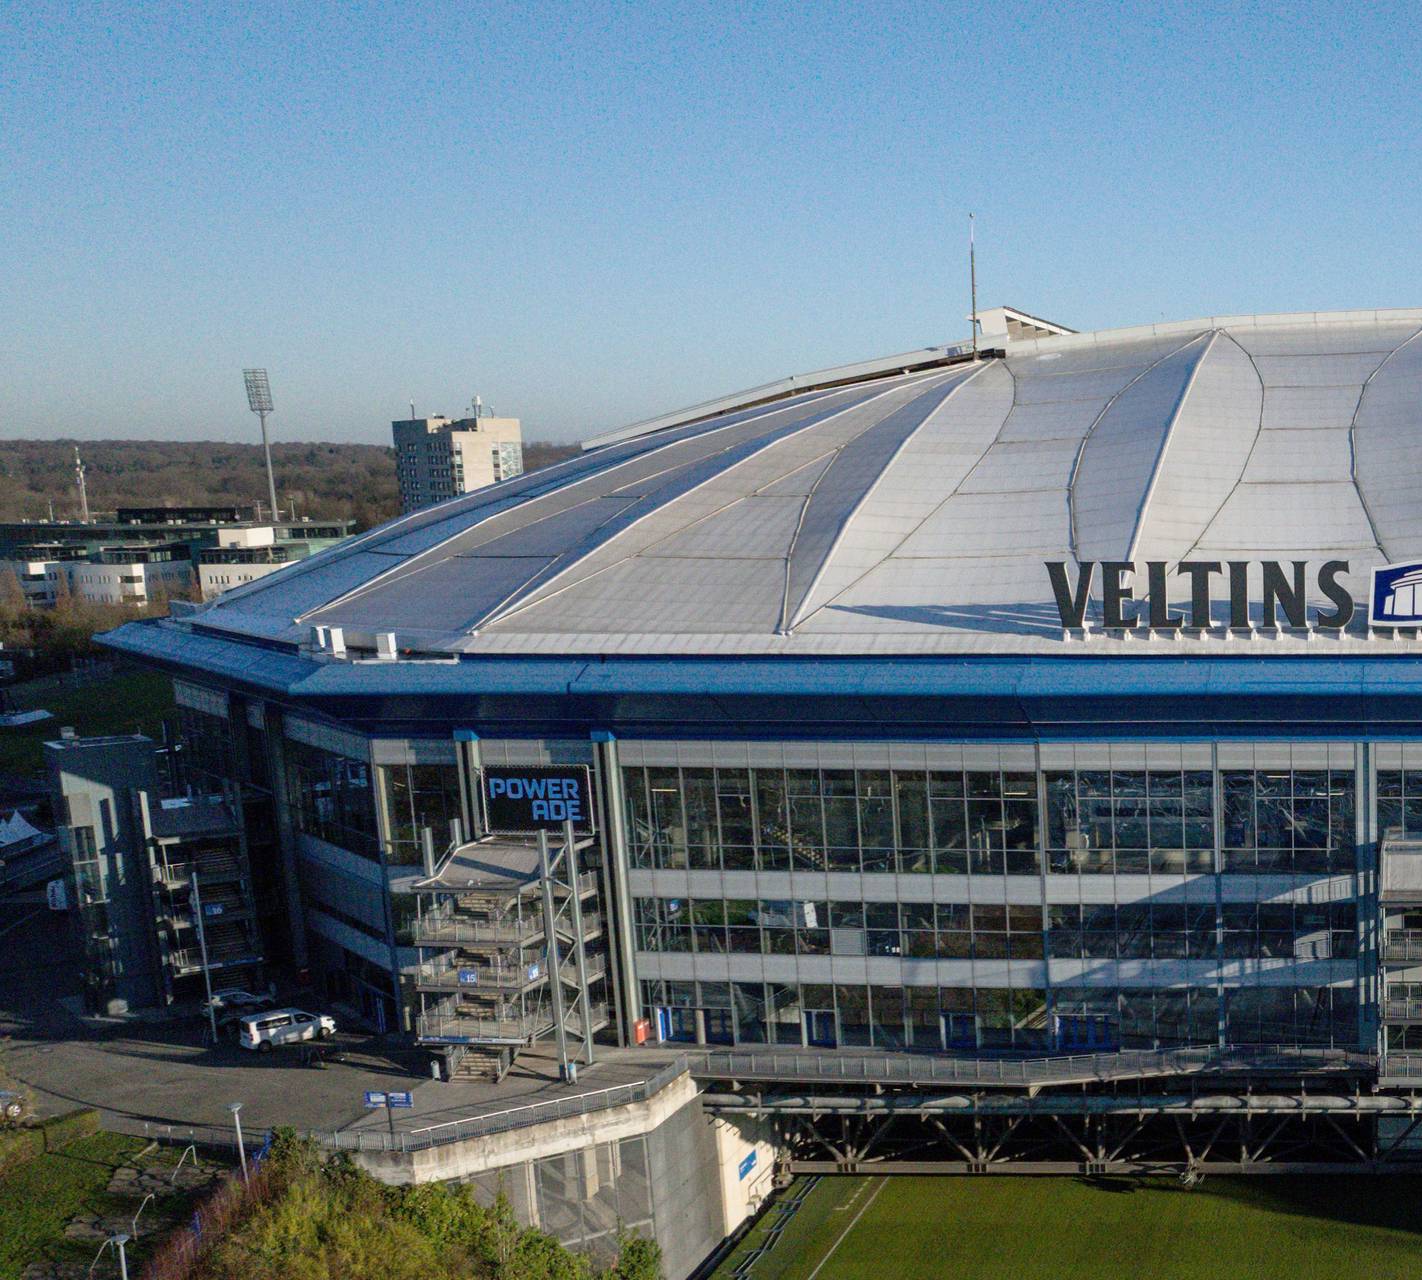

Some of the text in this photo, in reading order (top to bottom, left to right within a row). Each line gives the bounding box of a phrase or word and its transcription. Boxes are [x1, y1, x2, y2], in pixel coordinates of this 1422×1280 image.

[1044, 560, 1355, 628] VELTINS
[489, 778, 580, 799] POWER
[466, 973, 477, 983] 15
